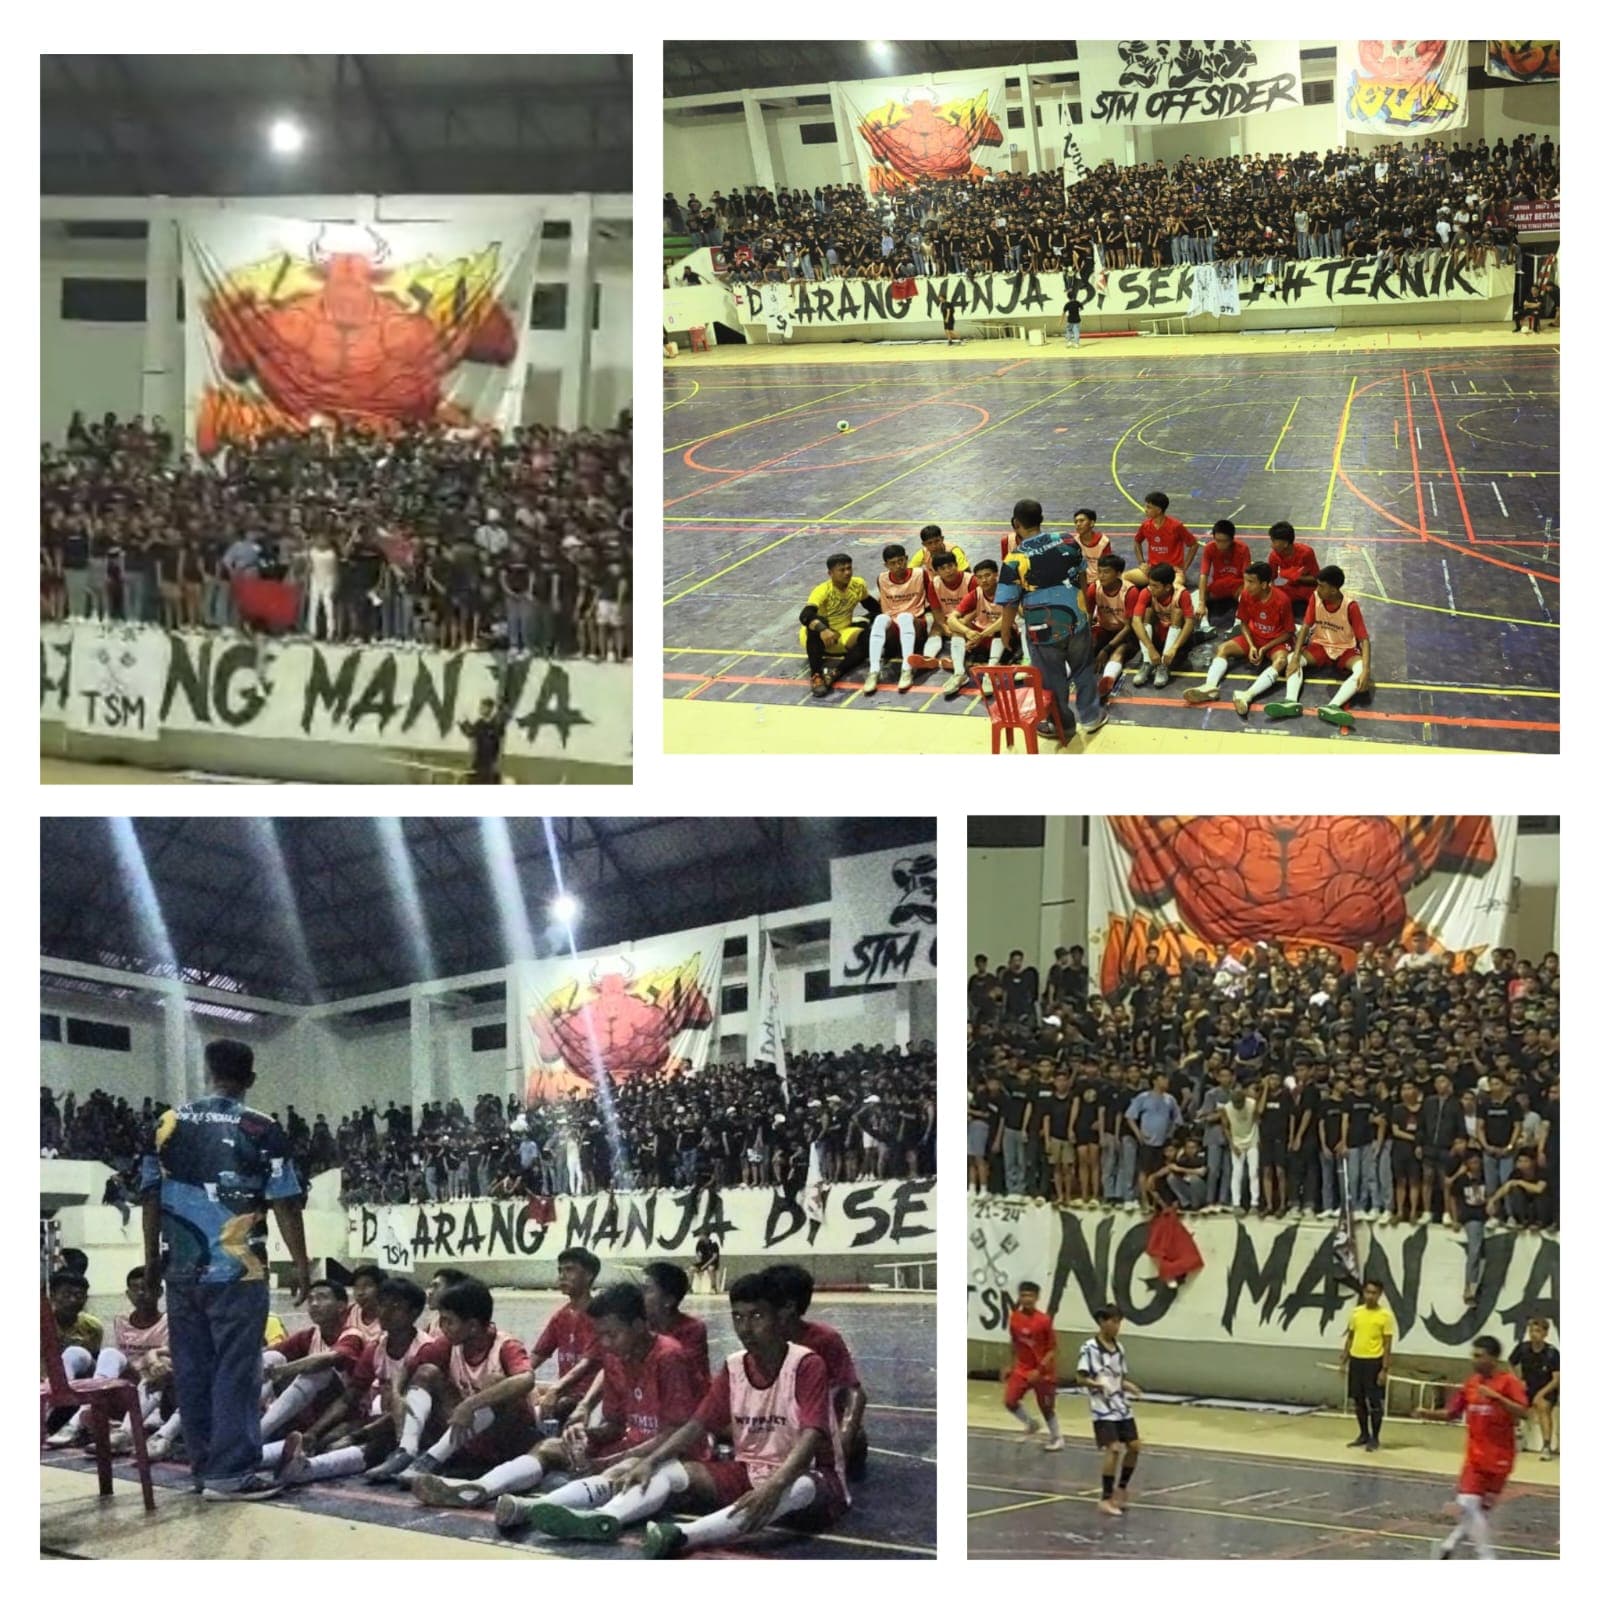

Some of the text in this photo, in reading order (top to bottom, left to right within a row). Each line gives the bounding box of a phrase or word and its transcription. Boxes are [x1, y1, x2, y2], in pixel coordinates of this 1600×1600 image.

[1091, 89, 1139, 124] STM
[747, 280, 911, 325] DARANG
[1313, 252, 1486, 303] TEKNIK
[81, 691, 145, 730] TSM
[844, 929, 921, 984] STM
[362, 1202, 549, 1259] DARANG
[566, 1183, 740, 1250] MANJA
